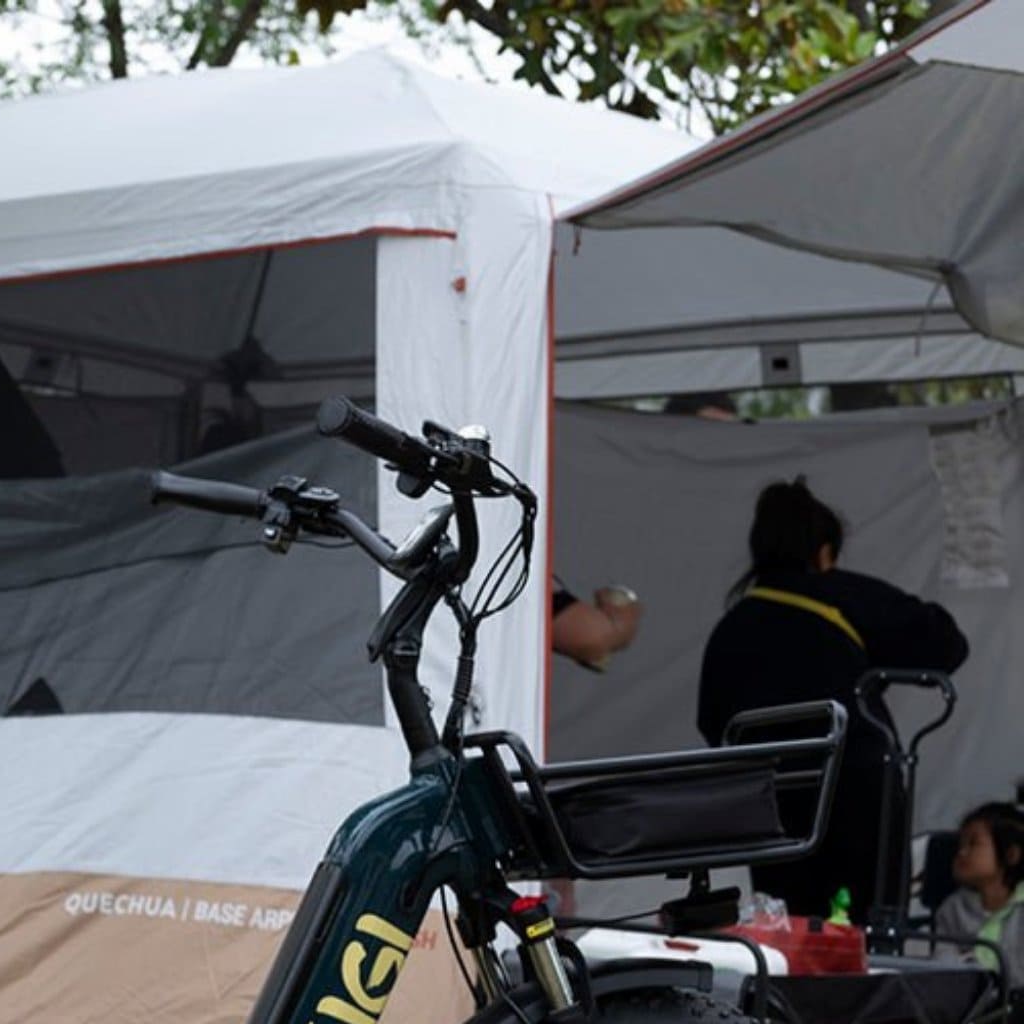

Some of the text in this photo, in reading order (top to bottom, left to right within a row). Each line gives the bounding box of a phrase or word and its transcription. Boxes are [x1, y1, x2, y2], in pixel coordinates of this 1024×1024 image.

[64, 891, 176, 919] QUECHUA
[194, 900, 248, 926] BASE
[249, 906, 295, 930] ARP
